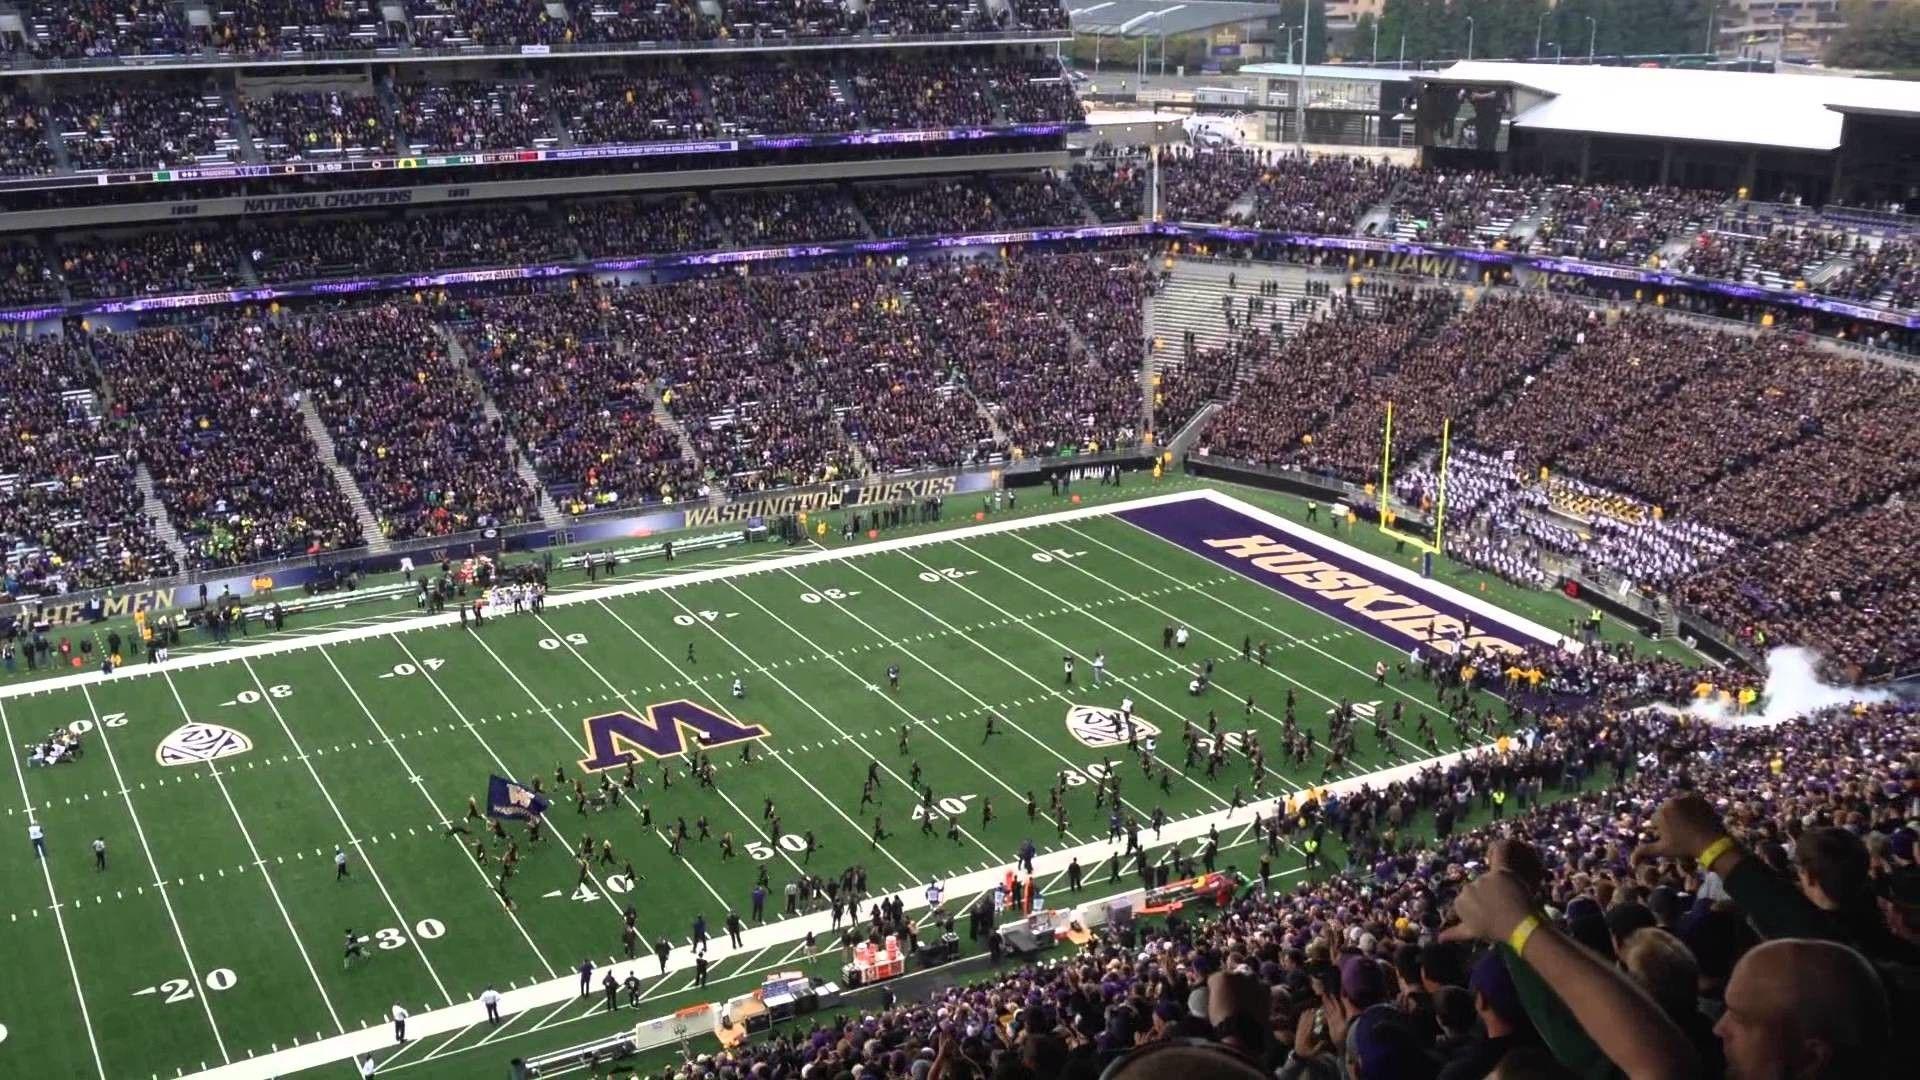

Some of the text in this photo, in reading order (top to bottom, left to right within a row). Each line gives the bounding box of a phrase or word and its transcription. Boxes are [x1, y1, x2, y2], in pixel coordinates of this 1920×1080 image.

[244, 190, 413, 213] NATIONAL CHAMPIONS
[684, 476, 957, 529] WASHINGTON HUSKIES
[103, 587, 176, 618] MEN
[1202, 534, 1525, 662] HUSKIES
[375, 918, 446, 950] 30
[160, 967, 238, 1003] 20
